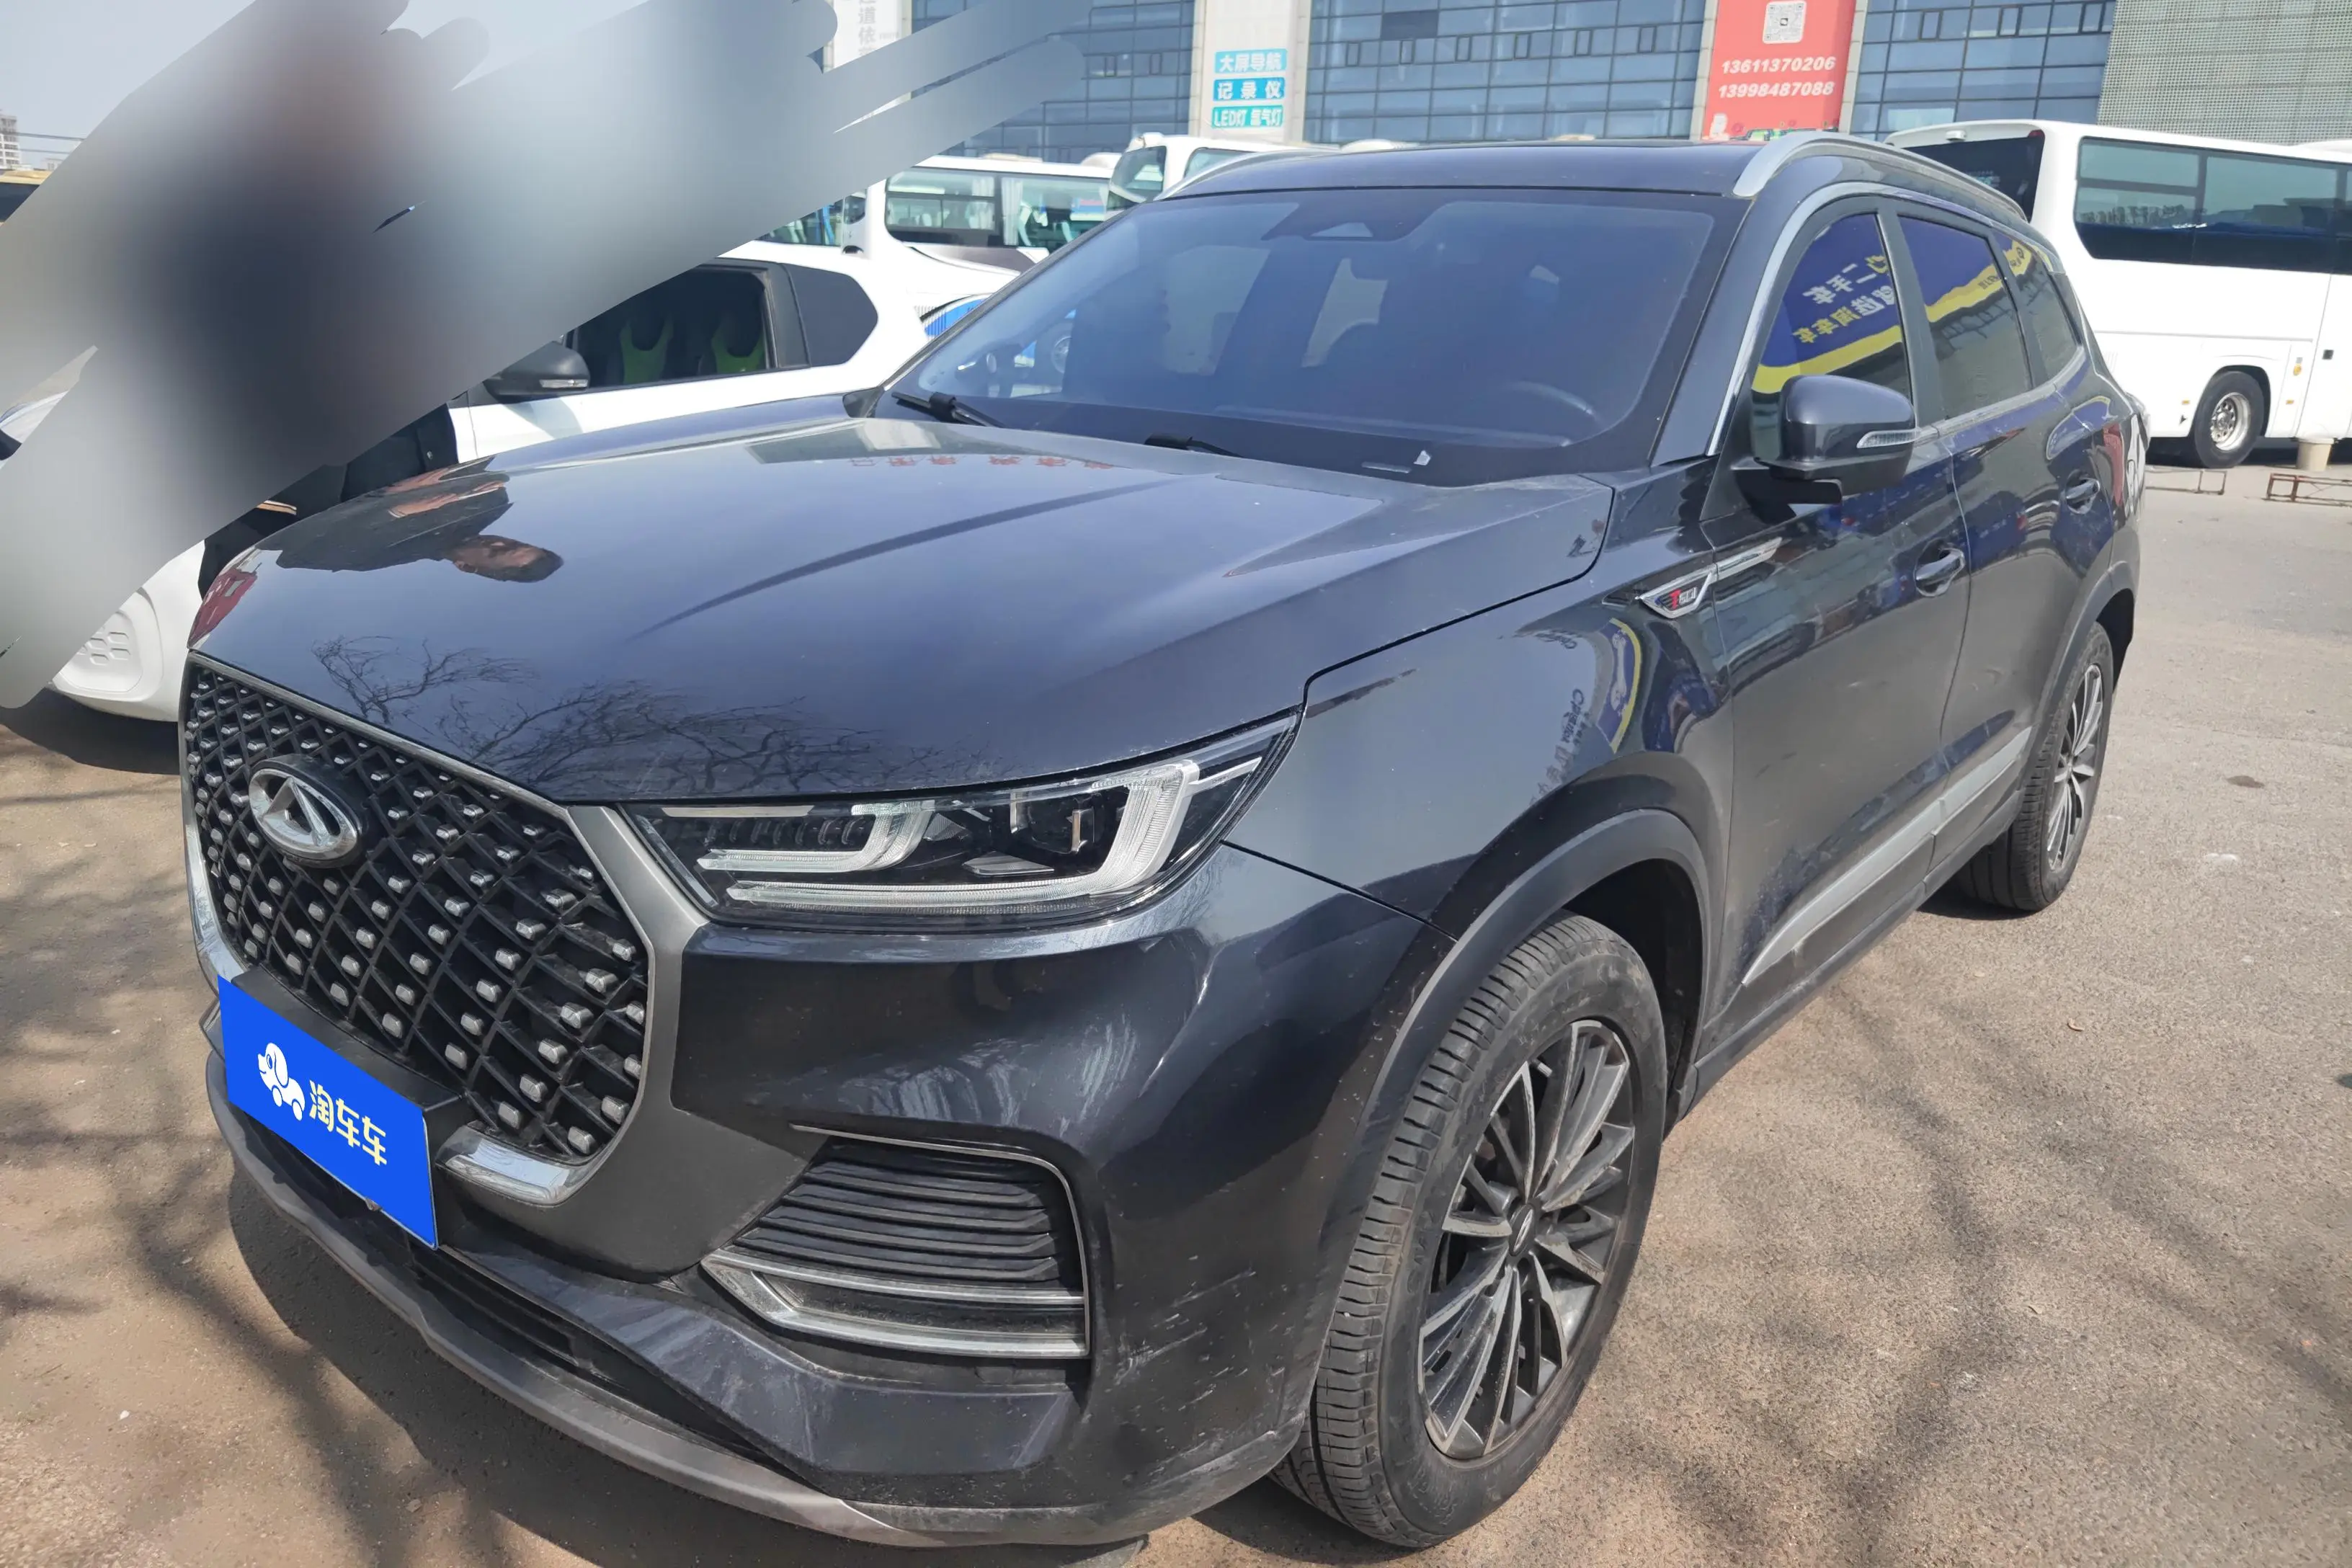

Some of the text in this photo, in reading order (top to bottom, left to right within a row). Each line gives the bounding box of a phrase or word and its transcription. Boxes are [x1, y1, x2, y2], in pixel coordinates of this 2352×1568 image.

[1219, 53, 1282, 72] 大屏导航
[1721, 56, 1837, 74] 13611370206
[1218, 80, 1281, 99] 记录仪
[1719, 81, 1835, 98] 13998487088
[1214, 109, 1248, 127] LED灯
